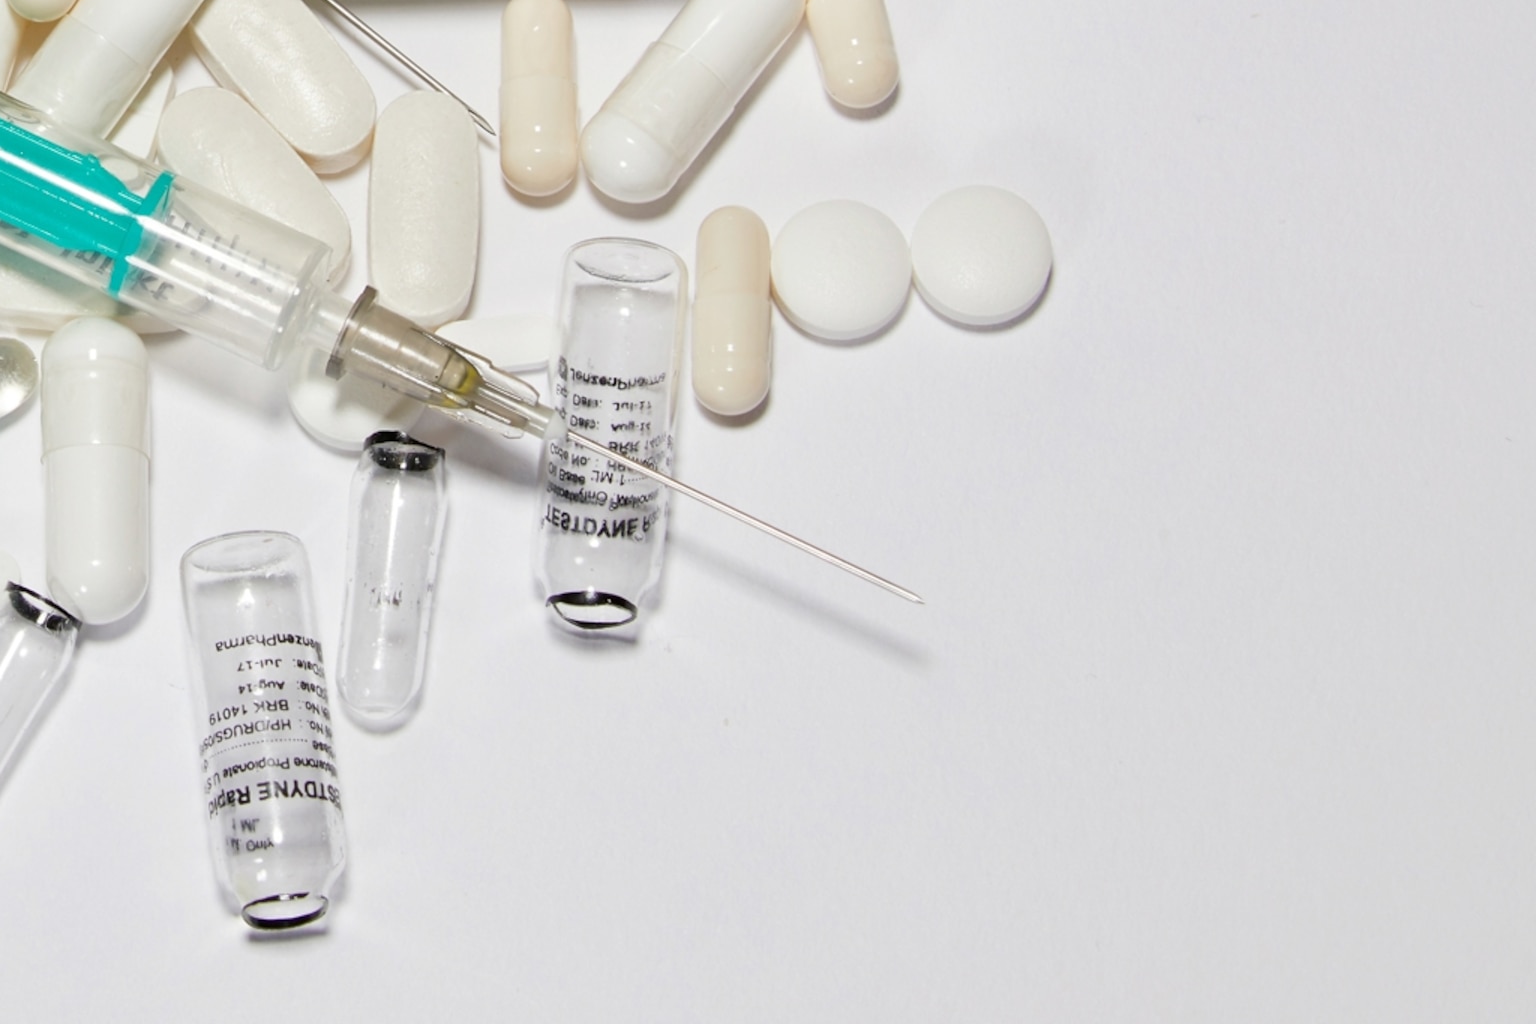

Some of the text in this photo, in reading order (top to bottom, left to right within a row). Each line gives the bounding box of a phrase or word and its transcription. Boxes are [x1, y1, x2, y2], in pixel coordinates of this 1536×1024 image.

[215, 633, 321, 657] enzenPharma
[209, 704, 248, 726] 14019
[253, 698, 289, 713] BRK
[223, 757, 290, 778] Propionate
[257, 780, 342, 810] ESTDYNE
